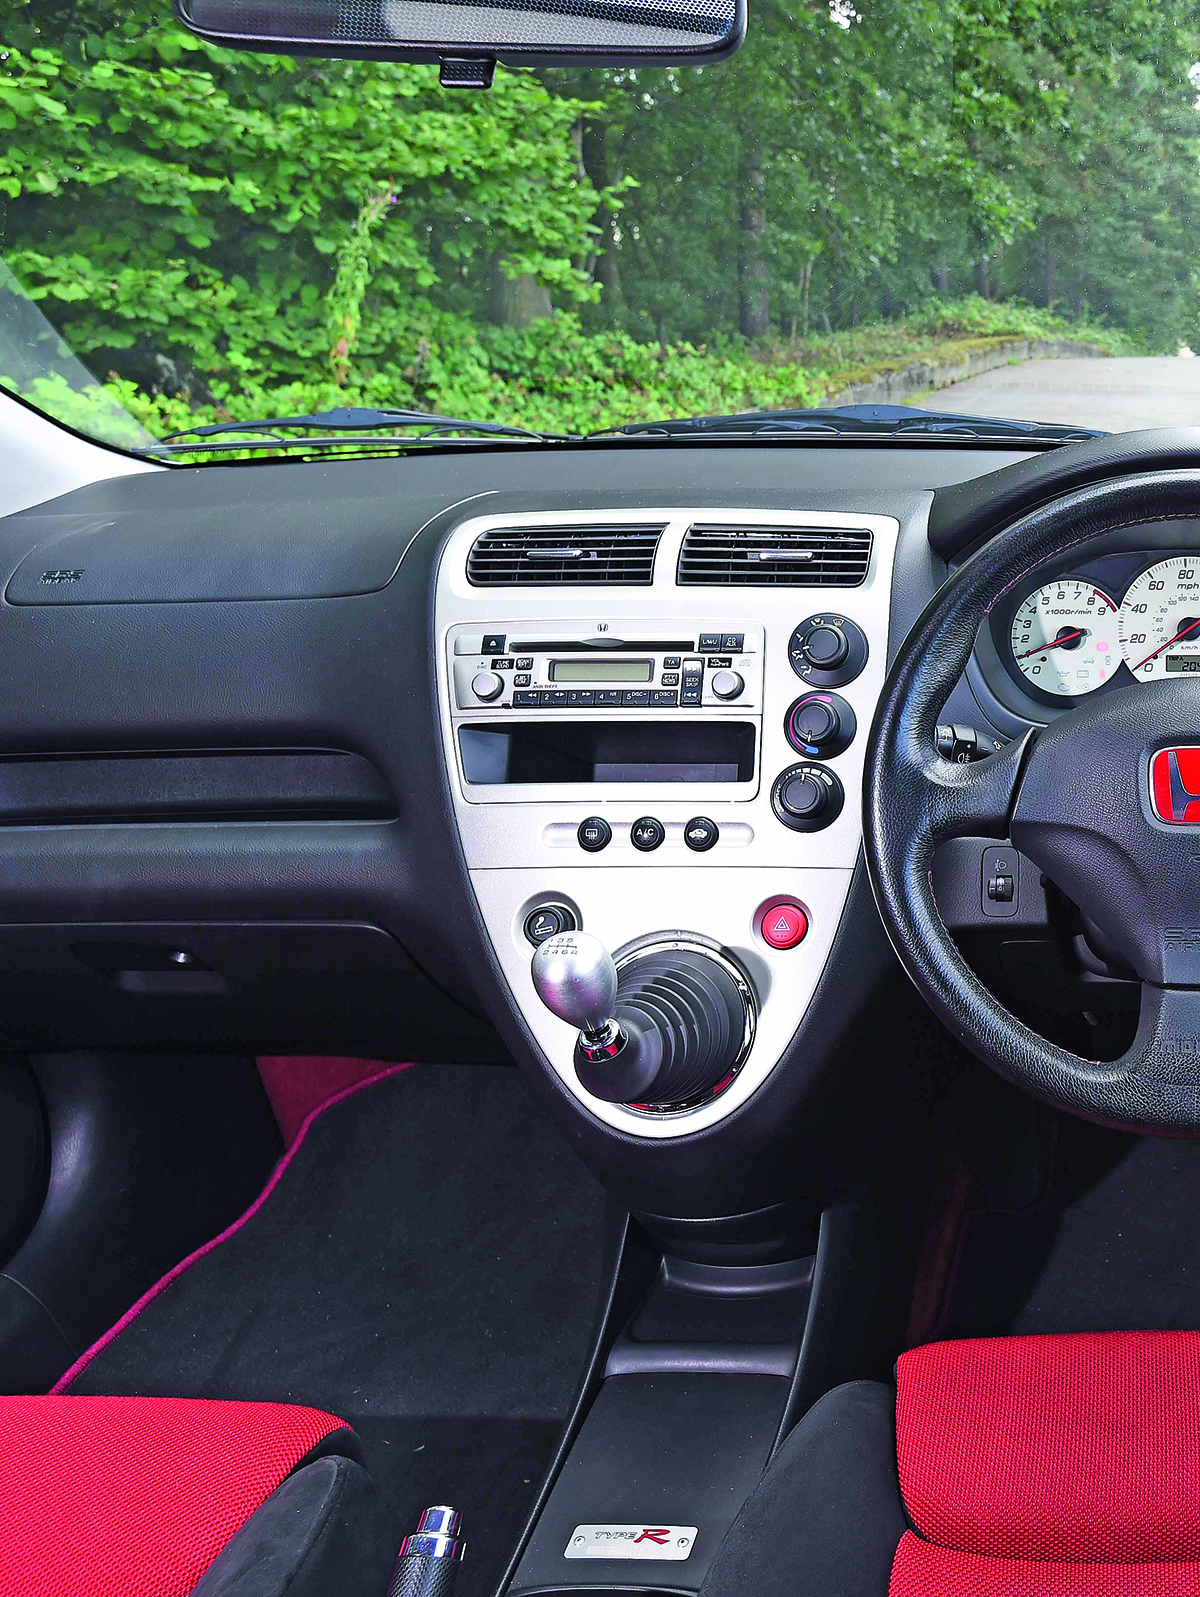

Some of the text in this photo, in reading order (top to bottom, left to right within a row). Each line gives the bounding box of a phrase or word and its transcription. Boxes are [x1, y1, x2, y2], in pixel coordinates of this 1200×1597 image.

[1178, 570, 1194, 579] 80
[1148, 581, 1164, 590] 60
[1177, 582, 1199, 590] mph
[1057, 591, 1065, 600] 6
[1074, 592, 1082, 600] 7
[1041, 597, 1050, 605] 5
[1087, 597, 1095, 605] 8
[1029, 606, 1037, 614] 4
[1097, 607, 1106, 615] 9
[1131, 603, 1147, 613] 40
[1023, 620, 1032, 628] 3
[1021, 635, 1030, 643] 2
[1130, 634, 1146, 643] 20
[1032, 666, 1041, 674] 0
[1144, 663, 1153, 672] 0
[636, 828, 654, 836] A/C
[594, 1528, 671, 1545] TYPE R
